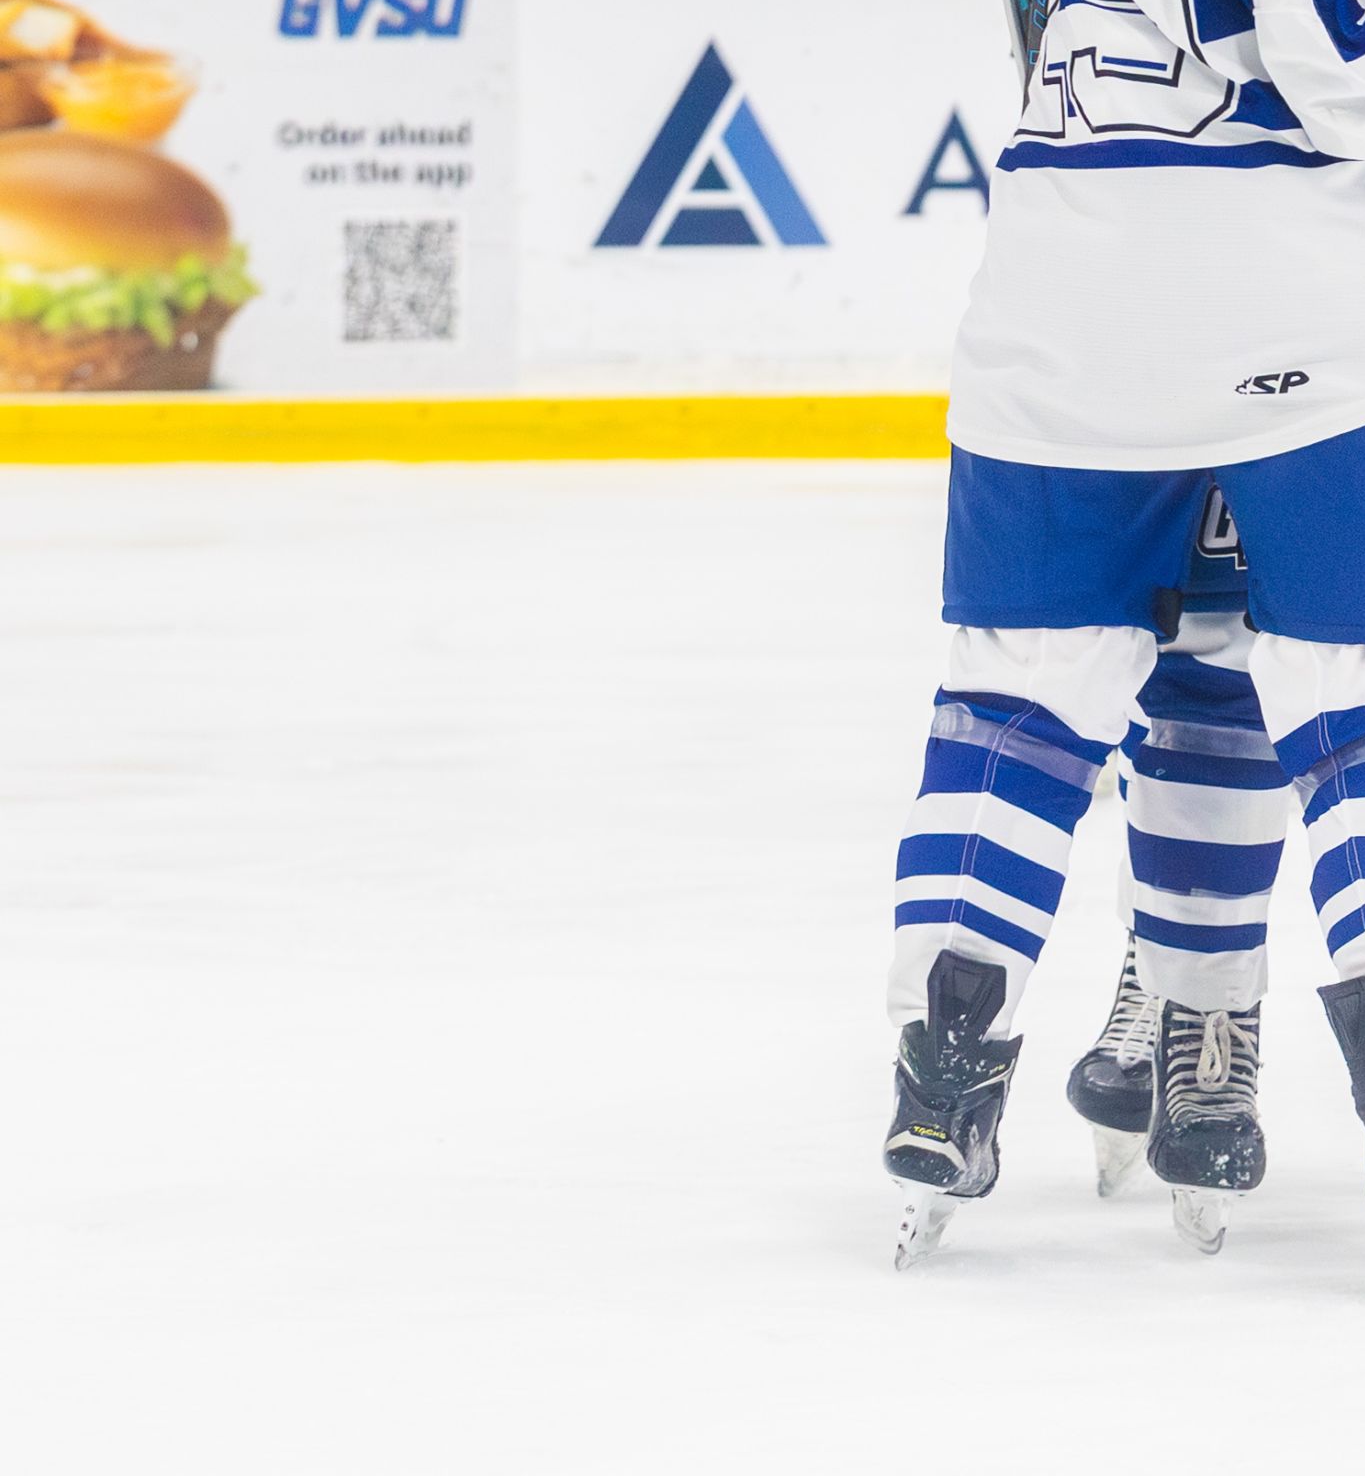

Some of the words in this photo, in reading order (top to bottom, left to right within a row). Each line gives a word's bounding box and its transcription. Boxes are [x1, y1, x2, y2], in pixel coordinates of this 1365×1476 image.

[279, 121, 365, 146] Order
[376, 121, 472, 145] ahead
[306, 163, 344, 183] on
[354, 160, 402, 183] the
[416, 163, 472, 188] app
